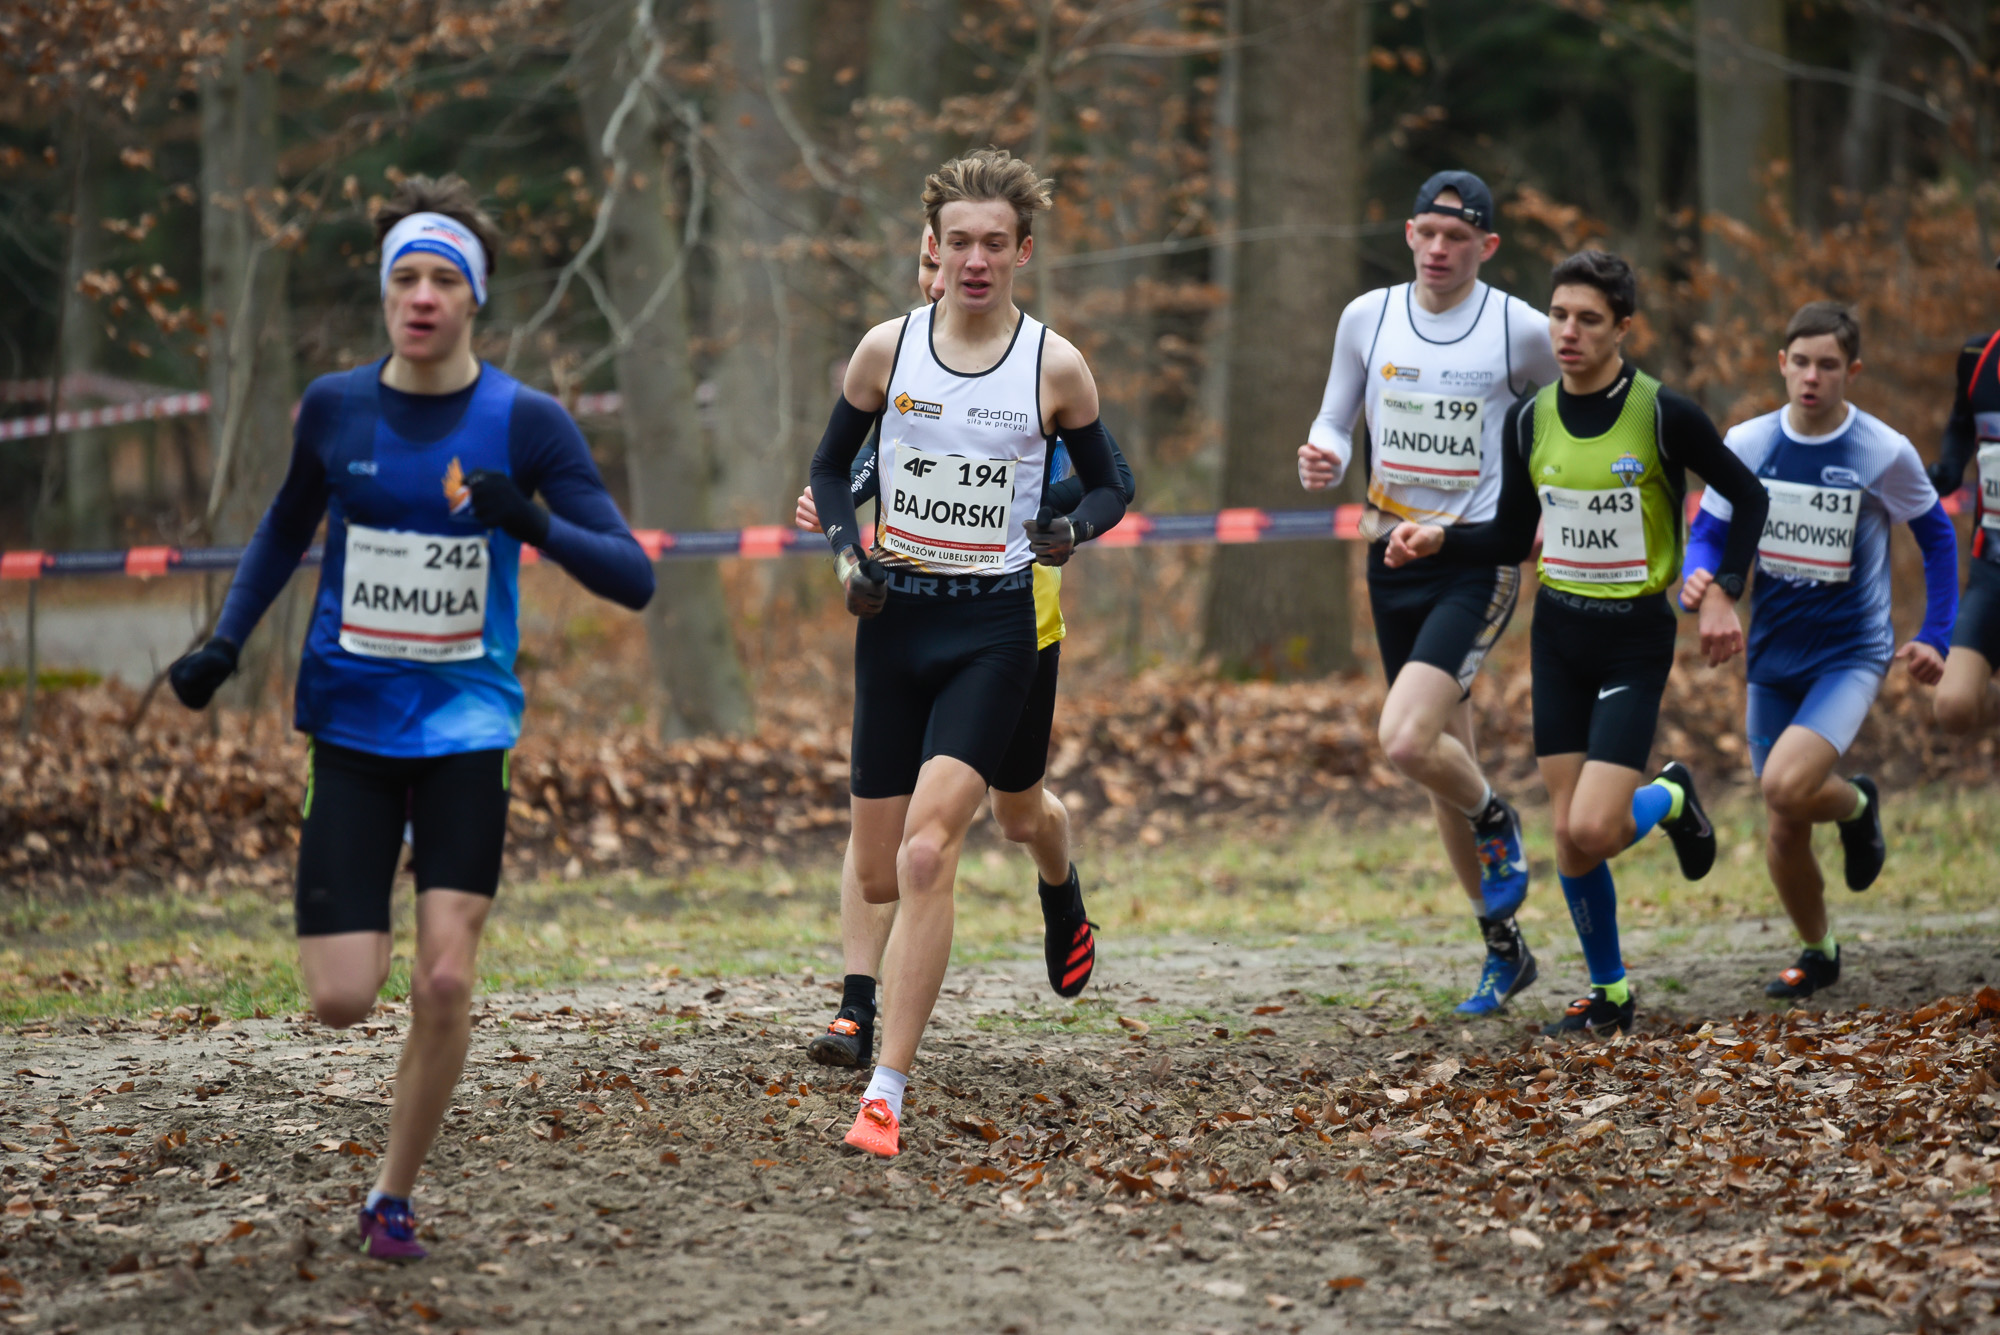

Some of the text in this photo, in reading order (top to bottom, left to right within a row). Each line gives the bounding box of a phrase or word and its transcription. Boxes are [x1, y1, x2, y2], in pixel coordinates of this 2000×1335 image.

[914, 402, 941, 414] OPTIMA
[1434, 400, 1478, 421] 199
[966, 417, 982, 426] siła
[995, 421, 1028, 433] precyzji
[1381, 428, 1475, 457] JANDUŁA
[903, 456, 938, 478] 4F
[957, 463, 1007, 489] 194
[893, 488, 1005, 529] BAJORSKI
[1587, 492, 1635, 515] 443
[1809, 492, 1854, 515] 431
[1561, 526, 1619, 549] FIJAK
[1761, 519, 1854, 548] ACHOWSKI
[424, 542, 482, 570] 242
[889, 537, 1000, 564] TOMASZÓW LUBELSKI 2021
[1546, 567, 1643, 580] TOMASZÓW LUBELSKI 2021
[351, 581, 479, 617] ARMUŁA
[1583, 598, 1634, 614] PRO
